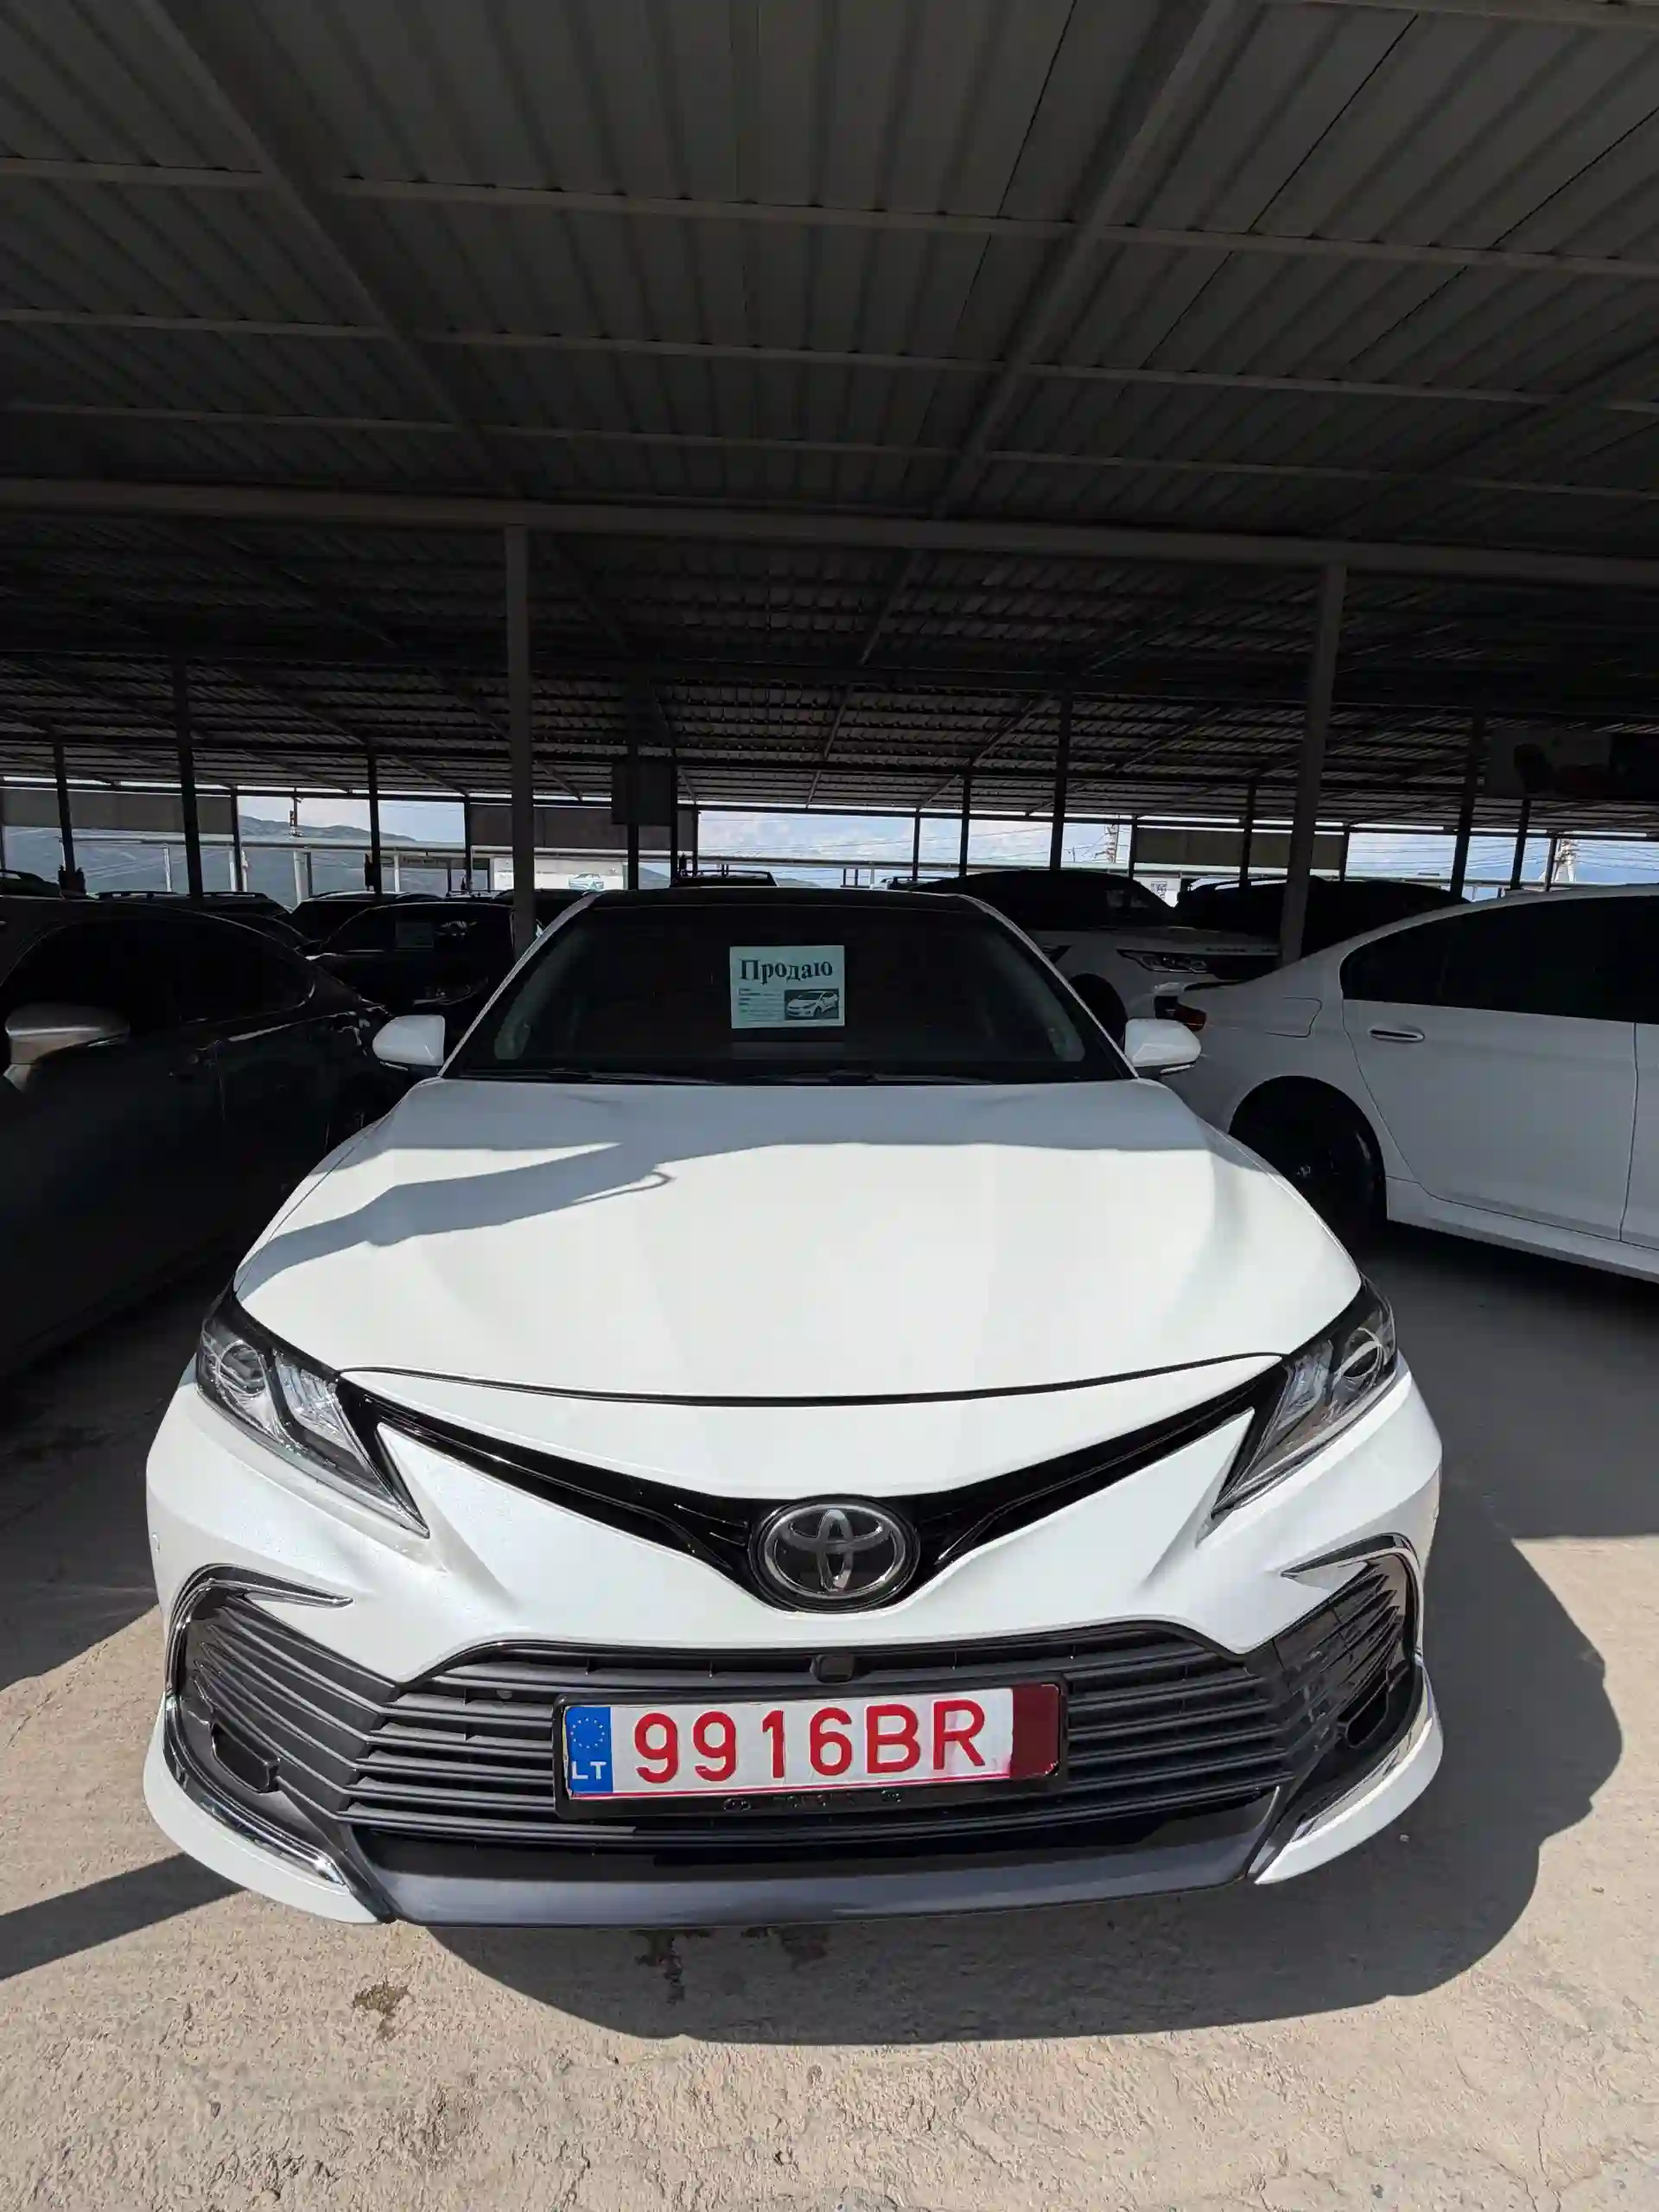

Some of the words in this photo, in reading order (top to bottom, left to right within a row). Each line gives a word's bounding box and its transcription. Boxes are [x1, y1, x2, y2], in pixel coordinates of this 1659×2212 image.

[739, 958, 833, 985] Продаю
[633, 1699, 986, 1784] 9916BR
[571, 1761, 607, 1780] LT
